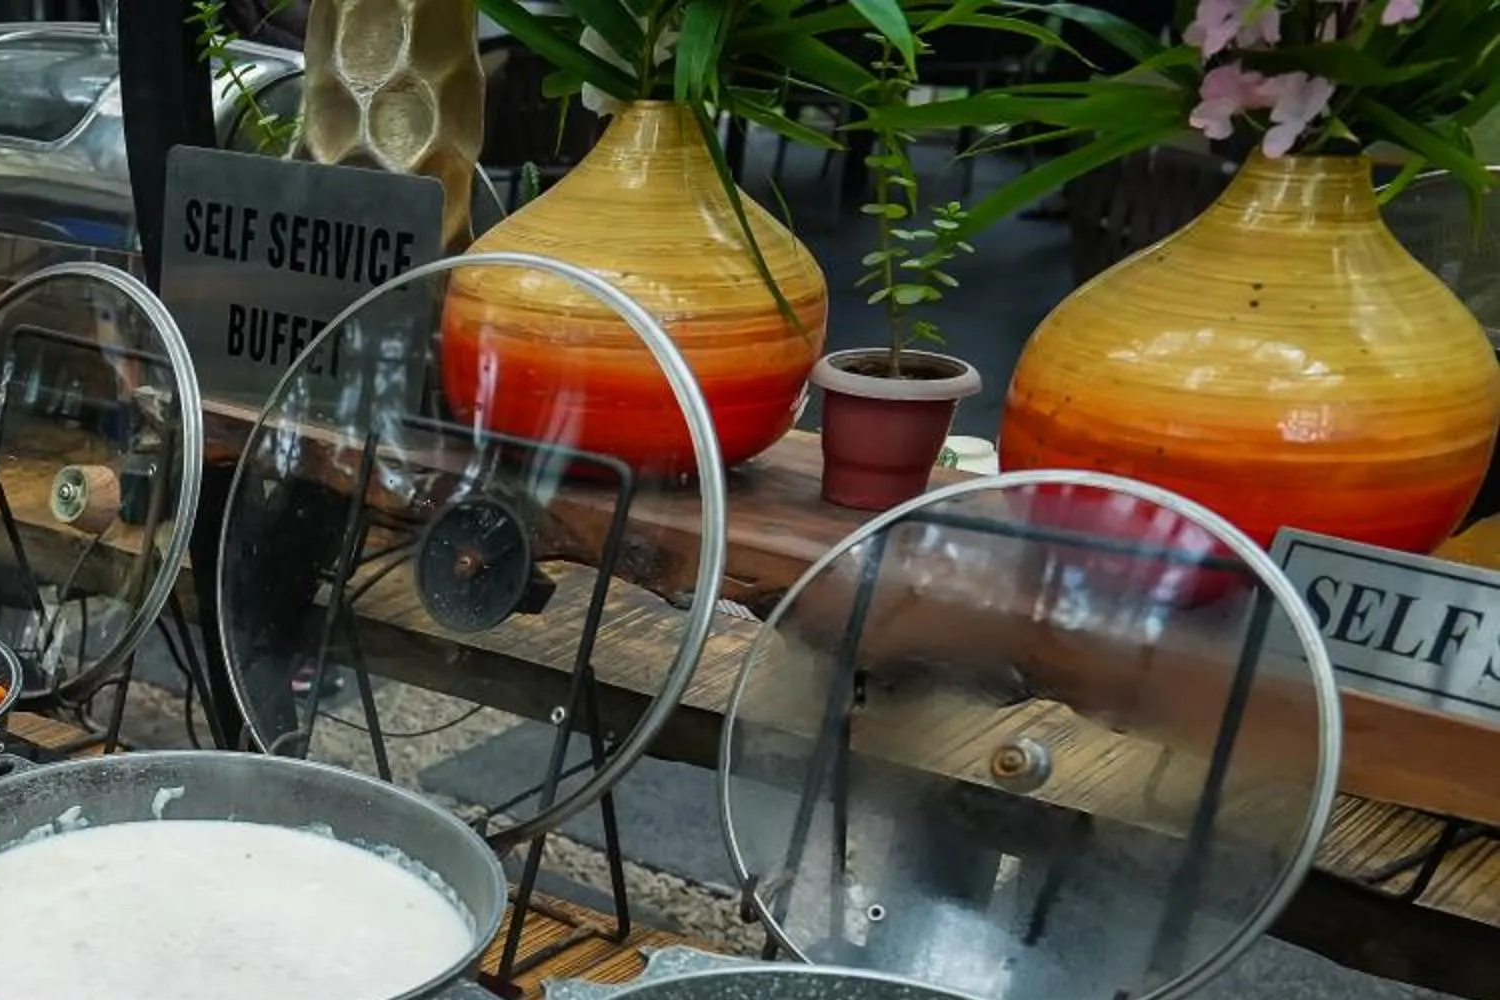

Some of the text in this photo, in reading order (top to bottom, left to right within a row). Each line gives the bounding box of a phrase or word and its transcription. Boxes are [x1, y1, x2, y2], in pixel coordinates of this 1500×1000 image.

[184, 199, 414, 291] SELF SERVICE
[227, 303, 347, 377] BUFFET
[1305, 575, 1484, 666] SELF
